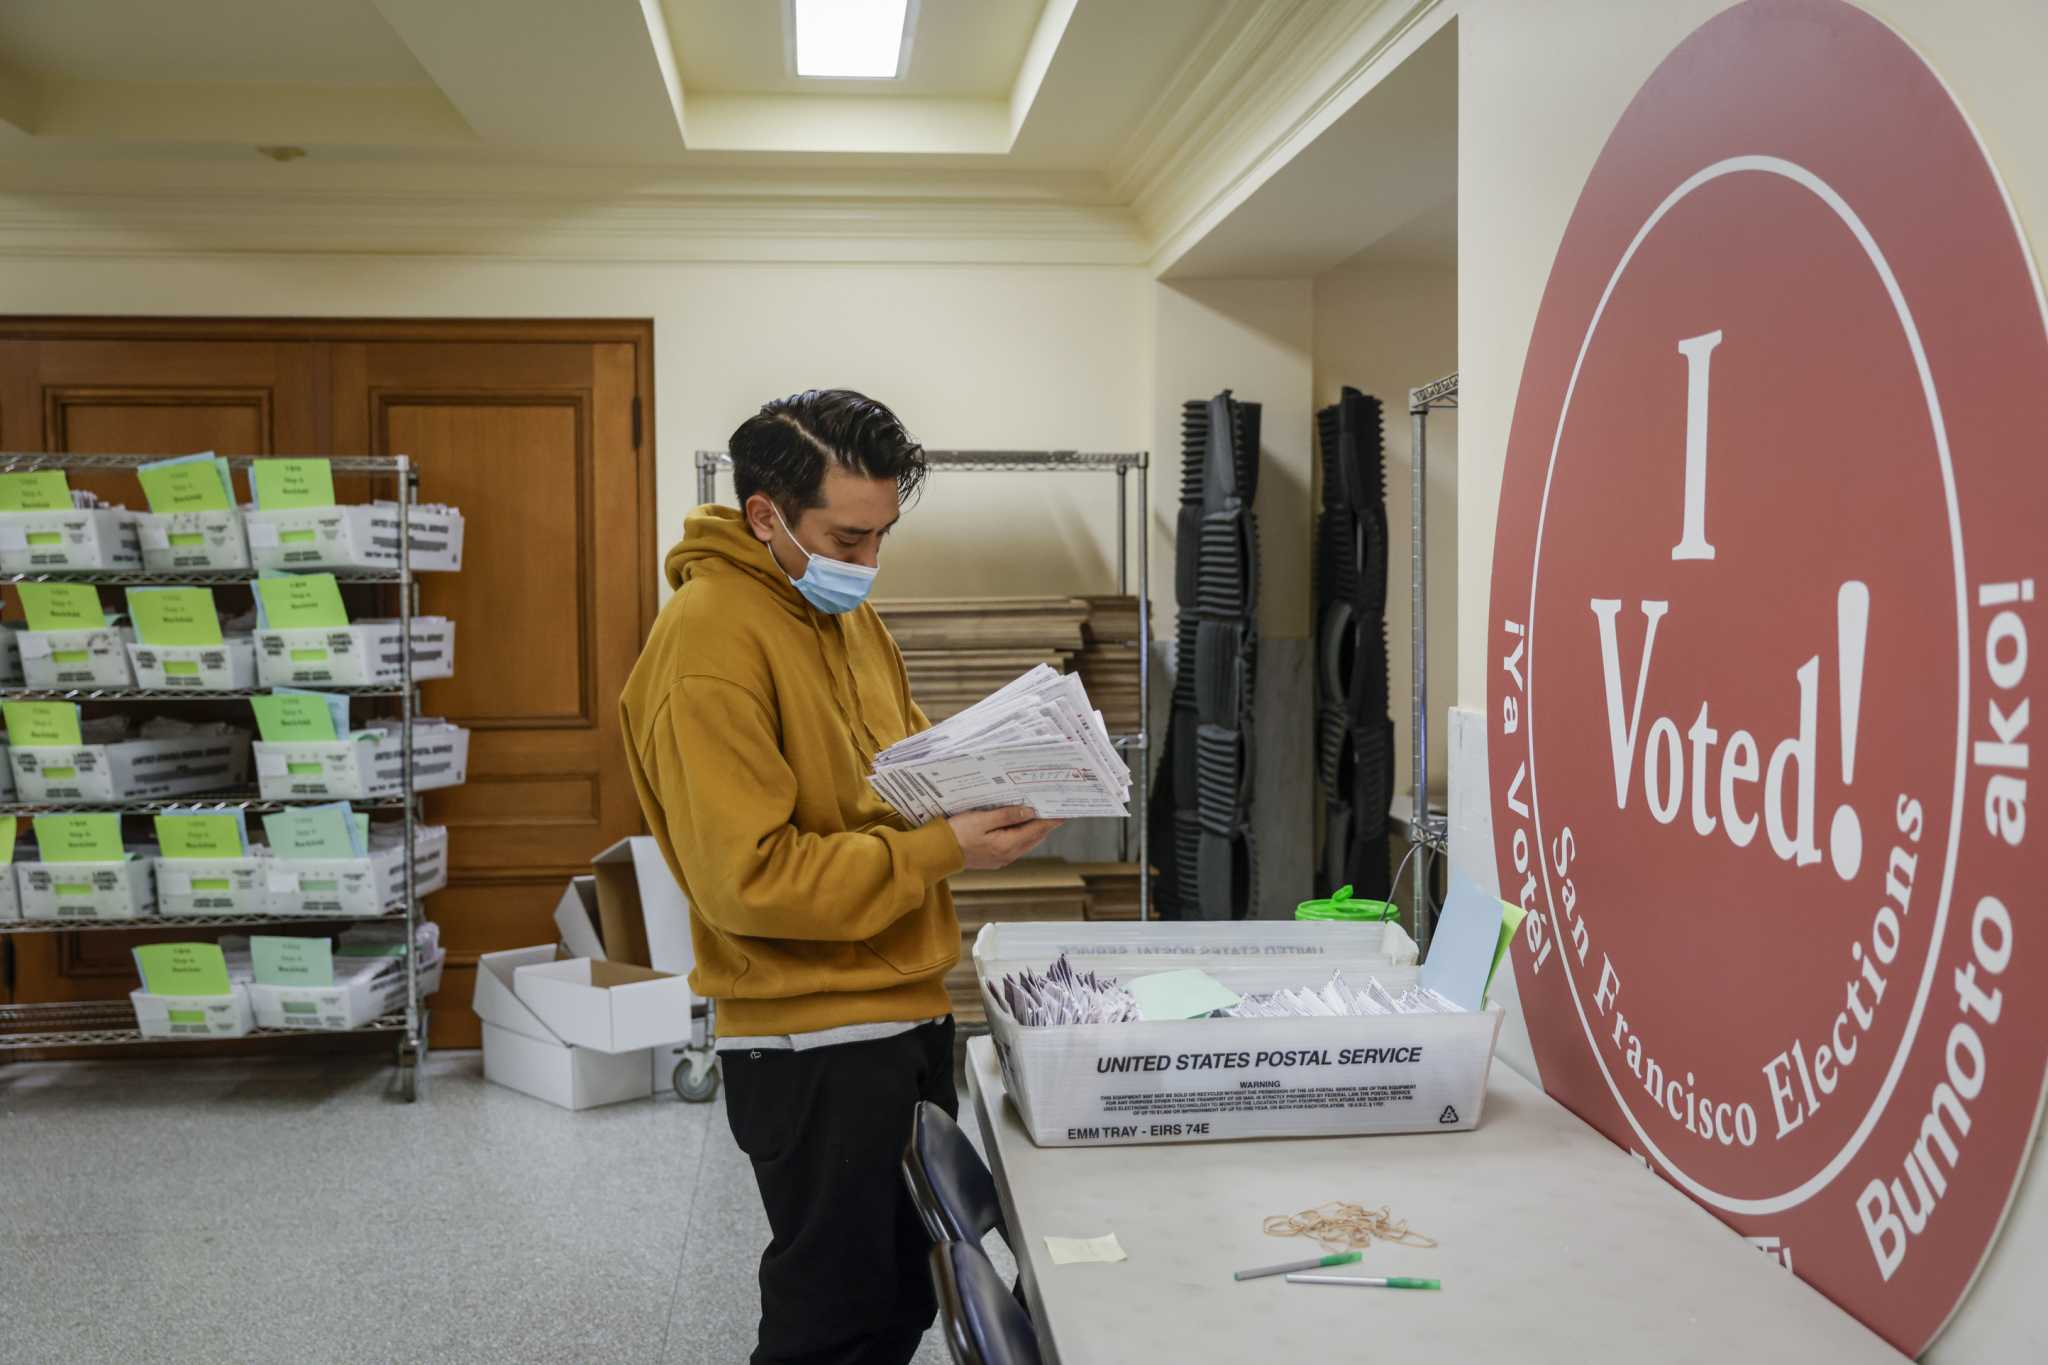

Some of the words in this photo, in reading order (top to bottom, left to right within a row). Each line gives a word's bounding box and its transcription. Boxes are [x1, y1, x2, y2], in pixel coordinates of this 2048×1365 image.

[1671, 329, 1724, 560] I
[1590, 579, 1871, 881] Voted!
[1553, 826, 1592, 968] San
[1593, 952, 1759, 1149] Francisco
[1762, 792, 1924, 1141] Elections
[1856, 896, 2014, 1282] Bumoto
[1971, 576, 2038, 847] ako!
[1067, 1127, 1100, 1140] EMM
[1102, 1126, 1138, 1139] TRAY
[1150, 1124, 1183, 1137] EIRS
[1185, 1123, 1210, 1136] 74E
[1097, 1056, 1171, 1074] UNITED
[1175, 1052, 1250, 1071] STATES
[1255, 1050, 1332, 1069] POSTAL
[1337, 1047, 1423, 1066] SERVICE
[1239, 1080, 1281, 1089] WARNING
